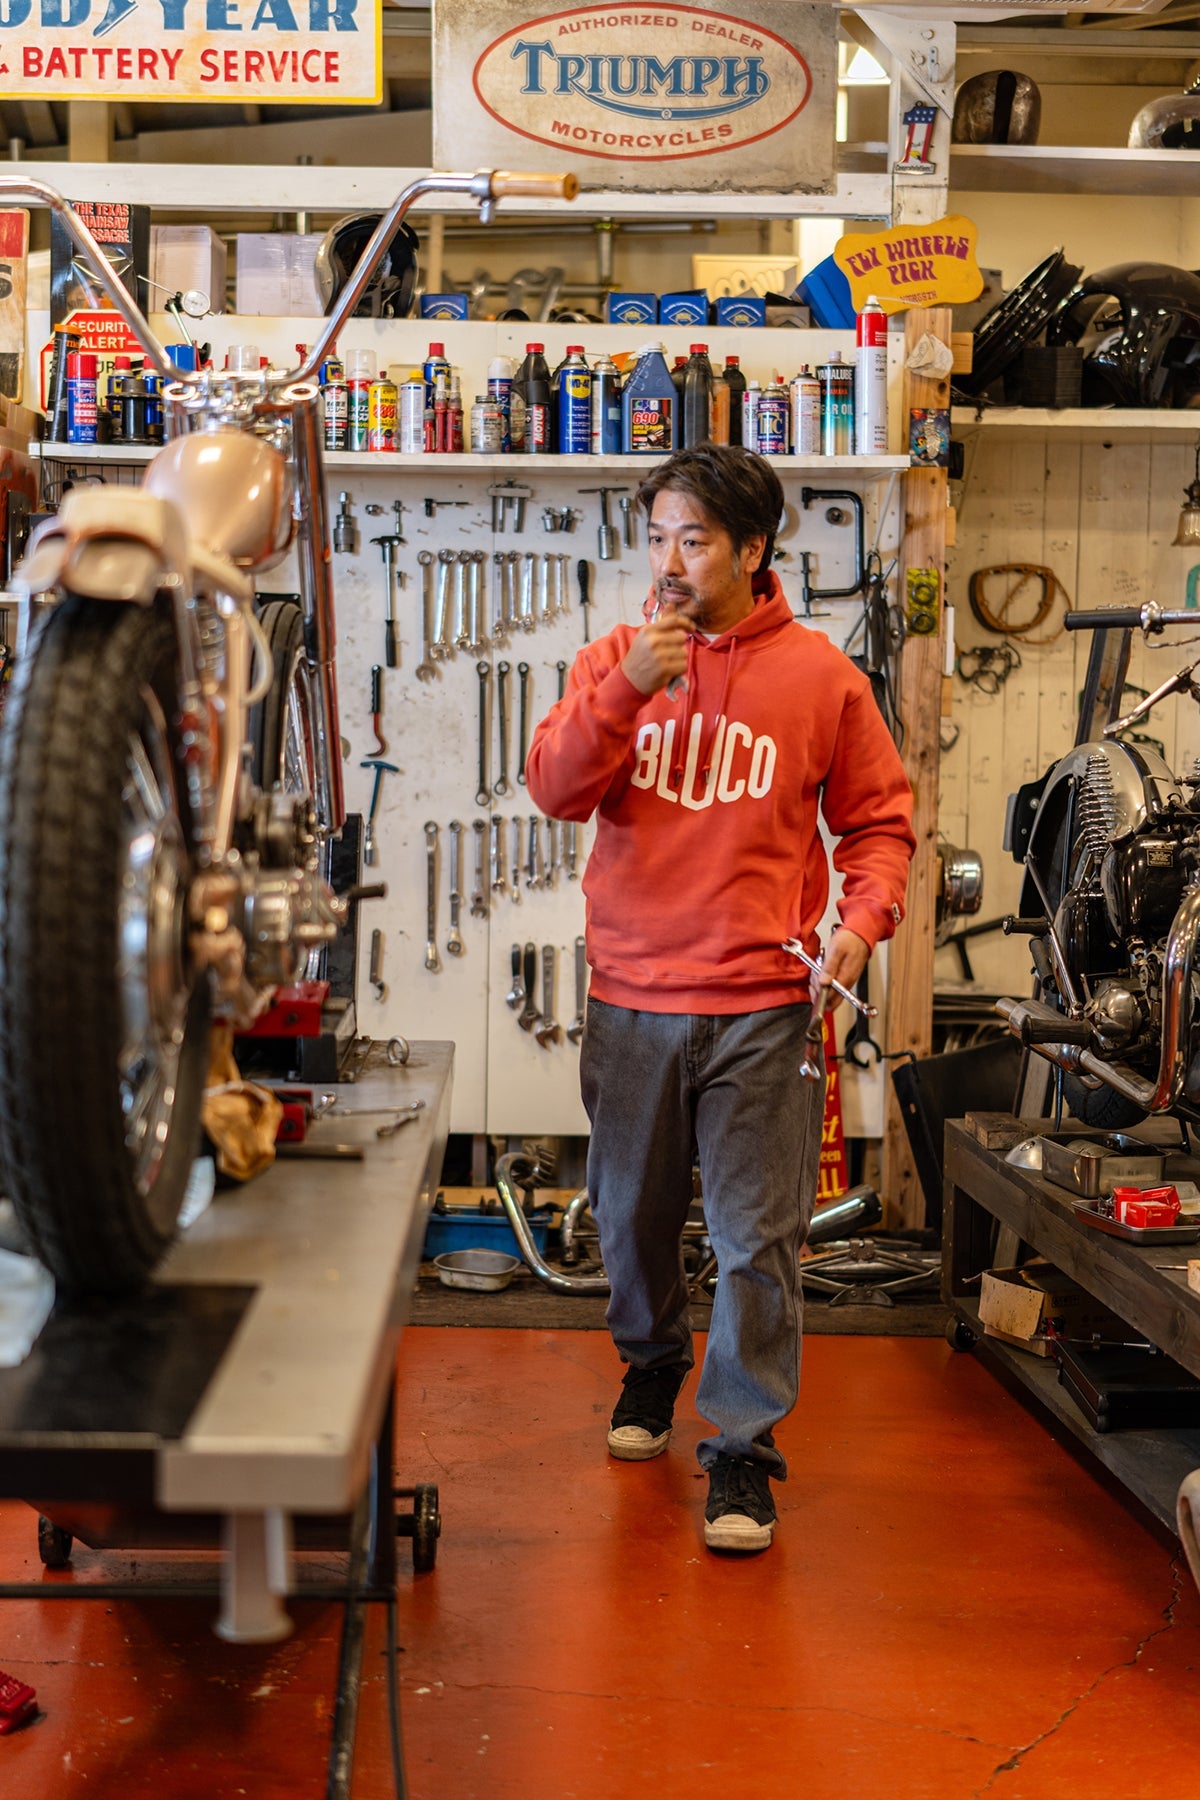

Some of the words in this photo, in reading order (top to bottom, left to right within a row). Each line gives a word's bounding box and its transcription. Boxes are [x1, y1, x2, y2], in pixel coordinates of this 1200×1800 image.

[558, 15, 678, 36] AUTHORIZED
[691, 21, 764, 51] DEALER
[23, 46, 184, 80] BATTERY
[200, 48, 339, 83] SERVICE
[510, 39, 771, 99] TRIUMPH
[551, 120, 733, 148] MOTORCYCLES
[73, 202, 94, 215] THE
[95, 203, 129, 216] TEXAS
[80, 216, 129, 229] HAINSAW
[89, 229, 130, 243] SSACRE
[884, 235, 969, 262] WHEELS
[886, 260, 937, 285] PICK
[79, 336, 126, 349] ALERT
[533, 407, 544, 442] MOTUL
[633, 412, 658, 425] 690
[631, 713, 777, 811] BLUCO
